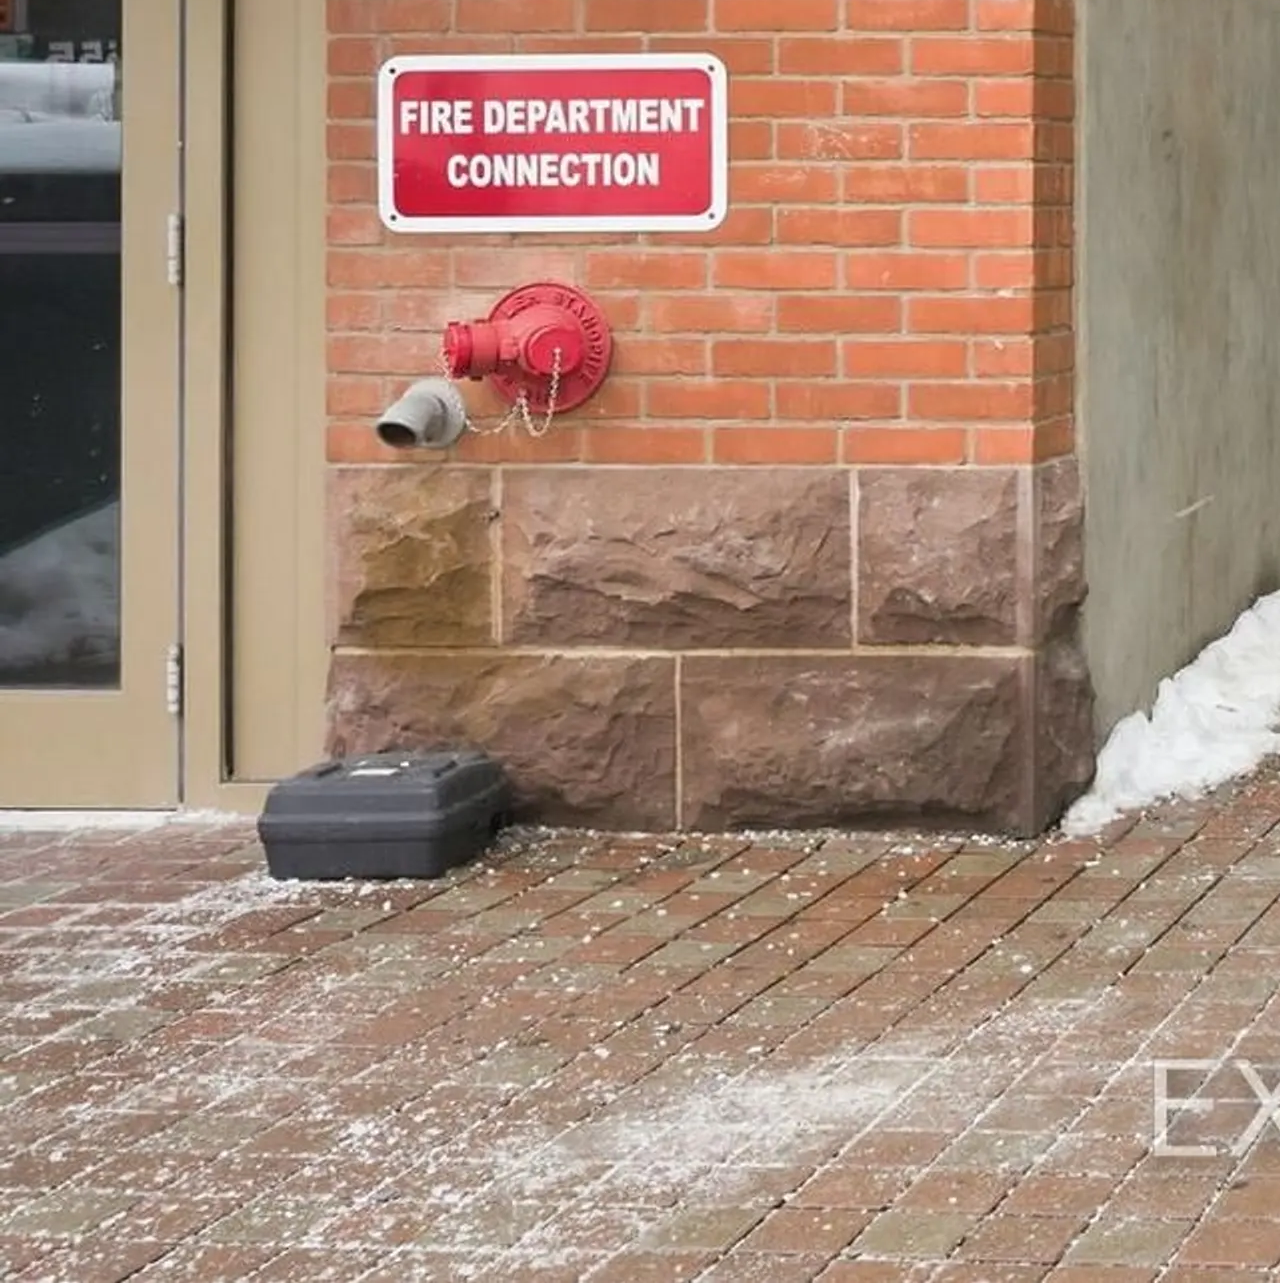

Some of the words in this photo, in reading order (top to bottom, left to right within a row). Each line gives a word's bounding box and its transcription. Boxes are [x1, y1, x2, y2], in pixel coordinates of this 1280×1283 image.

[400, 100, 474, 134] FIRE
[483, 98, 705, 134] DEPARTMENT
[447, 152, 660, 187] CONNECTION
